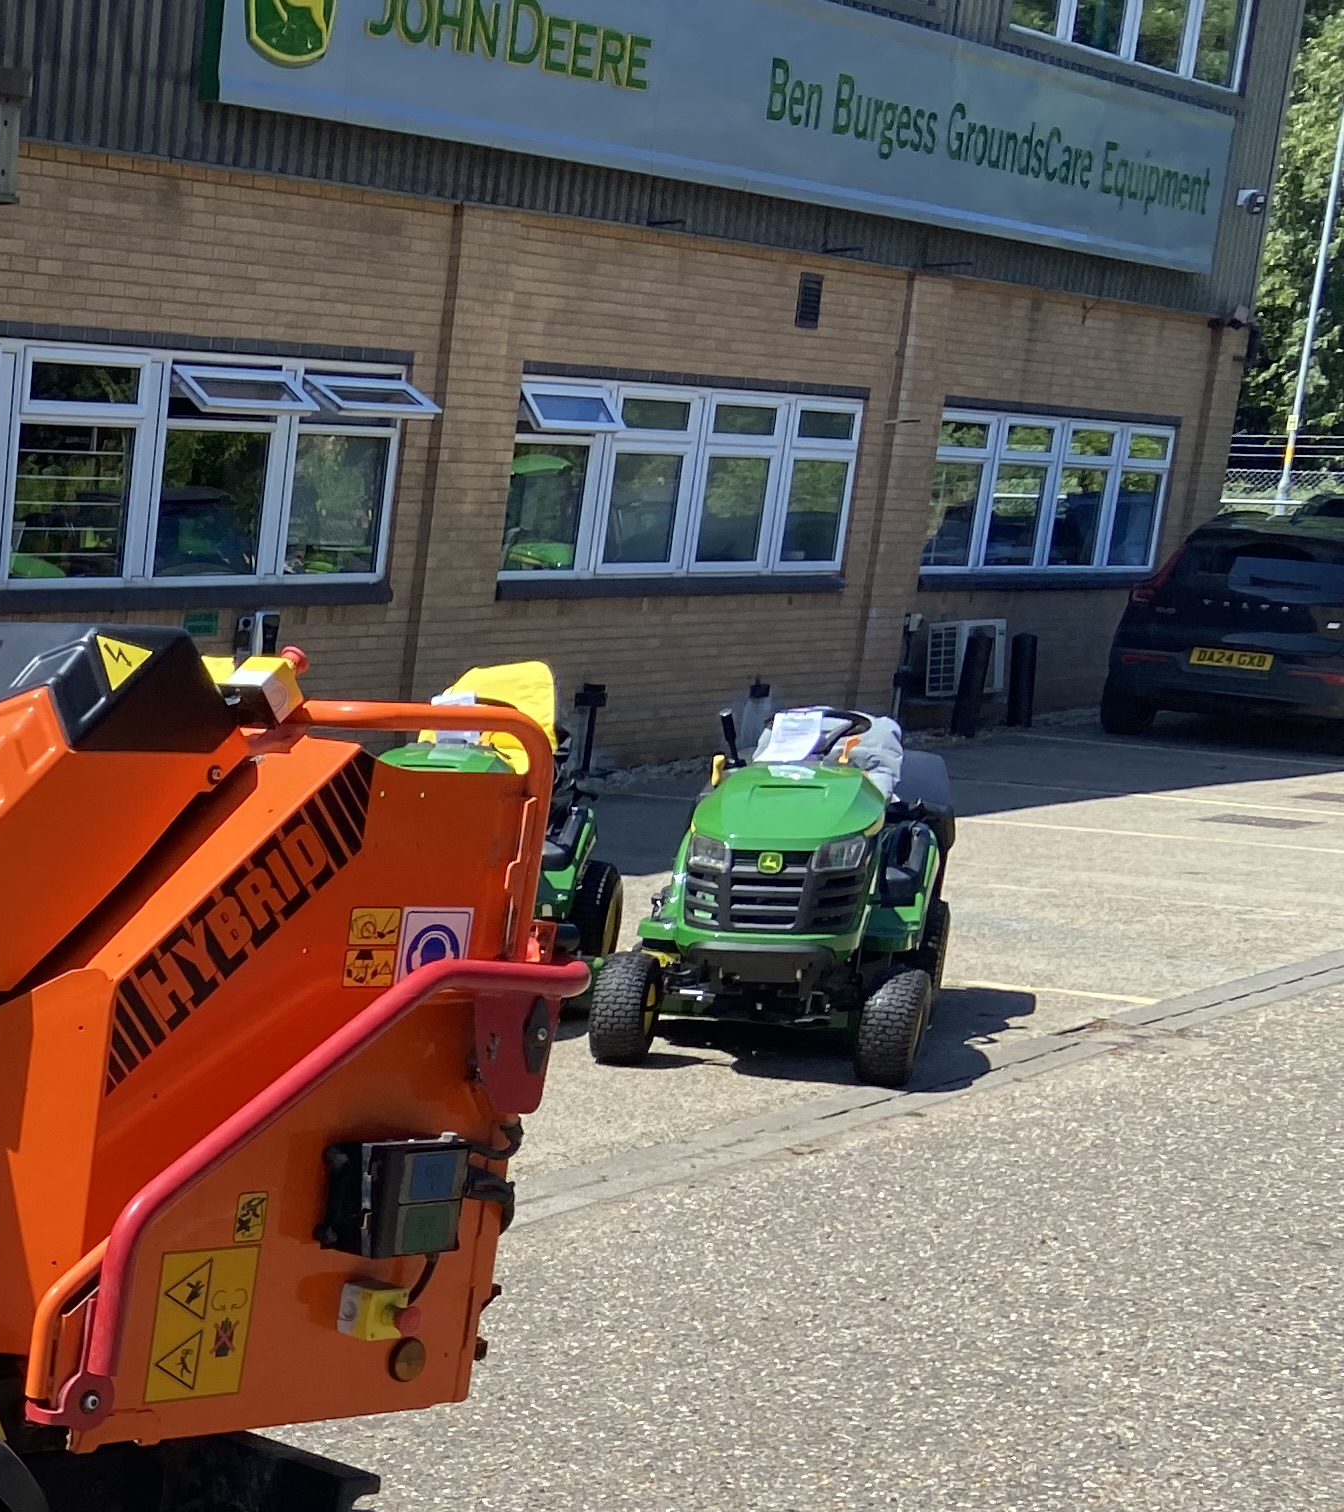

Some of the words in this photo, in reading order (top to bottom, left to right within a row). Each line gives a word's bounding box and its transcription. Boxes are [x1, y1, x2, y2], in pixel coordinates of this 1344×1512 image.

[506, 0, 653, 91] DEERE
[765, 57, 823, 131] Ben
[831, 73, 939, 161] Burgess
[945, 102, 1094, 191] GroundsCare
[1100, 141, 1211, 216] Equipment
[139, 823, 330, 1022] HYBRID
